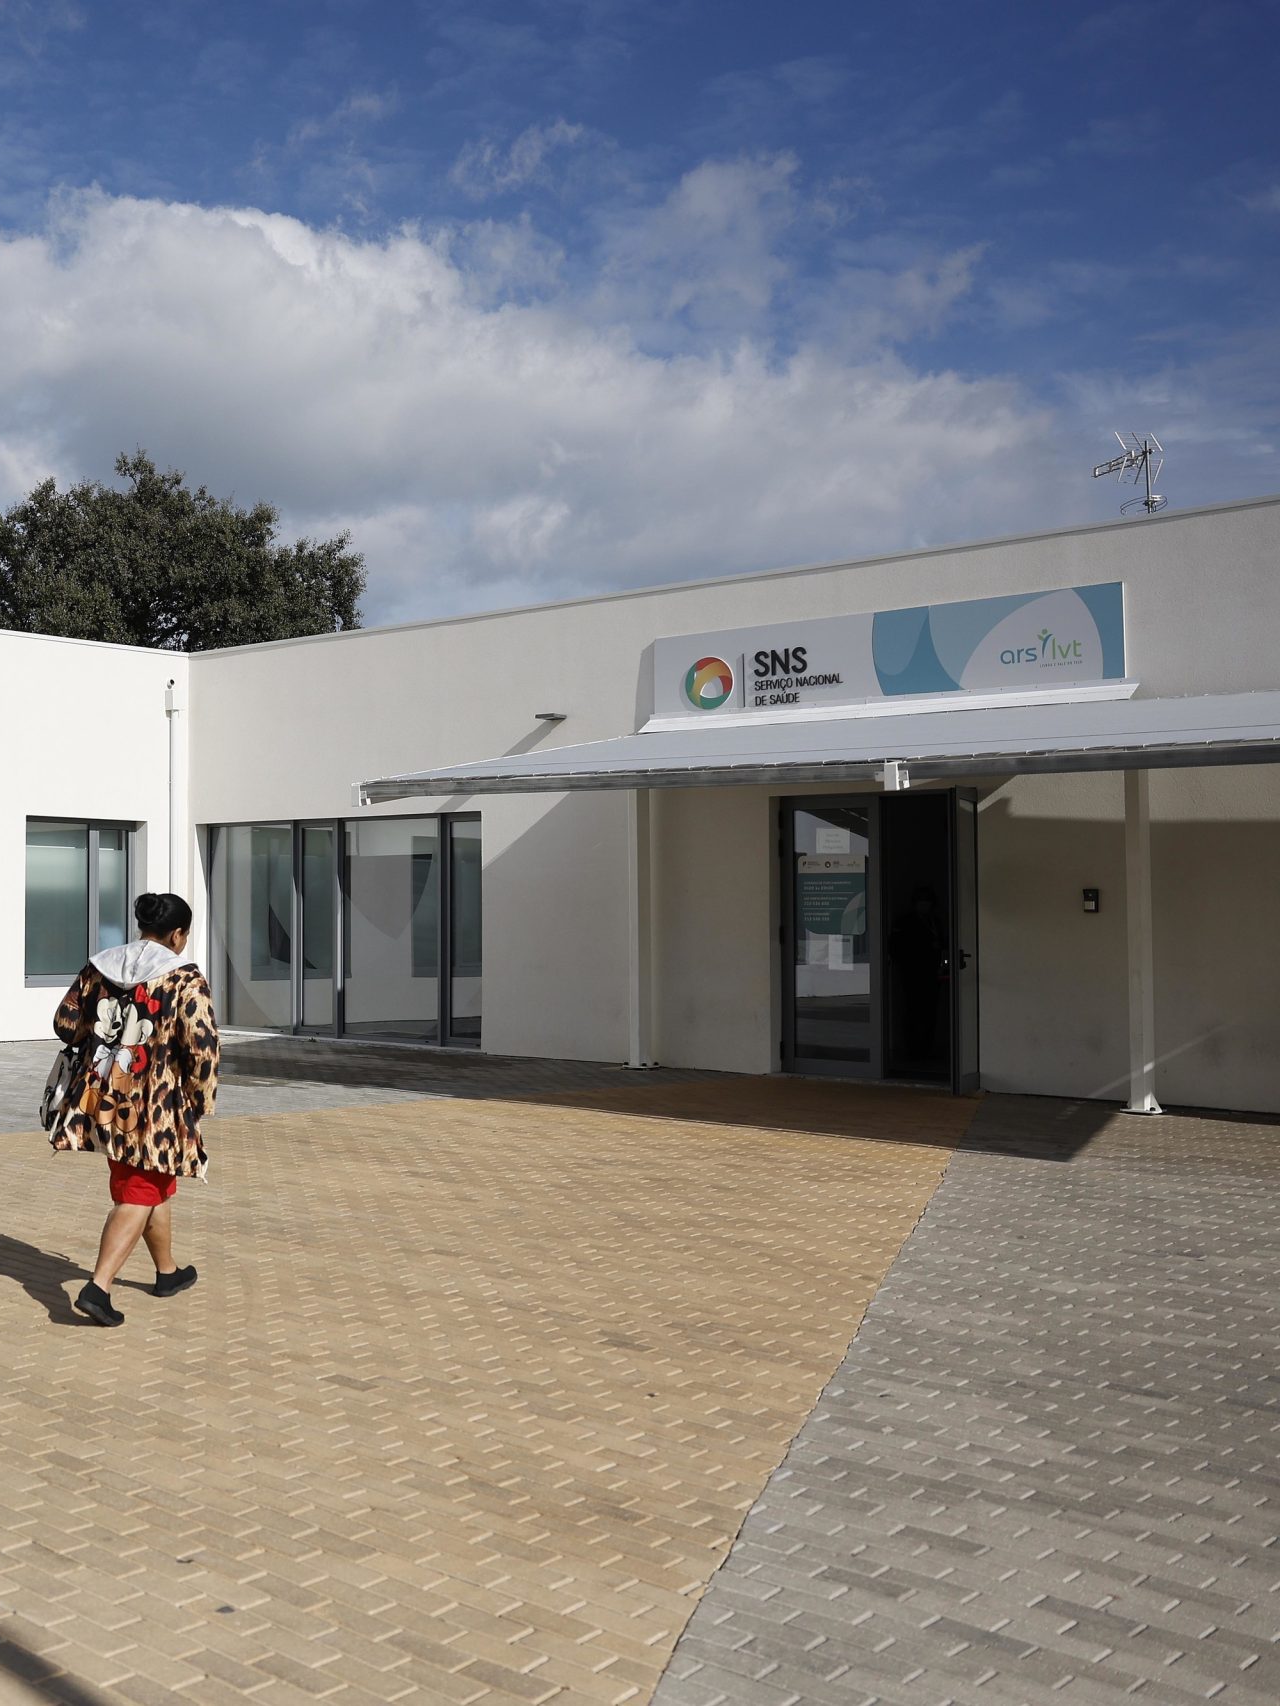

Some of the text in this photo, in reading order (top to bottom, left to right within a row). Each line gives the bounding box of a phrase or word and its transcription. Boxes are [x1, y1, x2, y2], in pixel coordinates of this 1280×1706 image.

[753, 646, 808, 678] SNS
[1000, 647, 1038, 665] ars
[754, 672, 844, 692] SERVIÇO NACIONAL
[754, 691, 801, 707] DE SAÚDE
